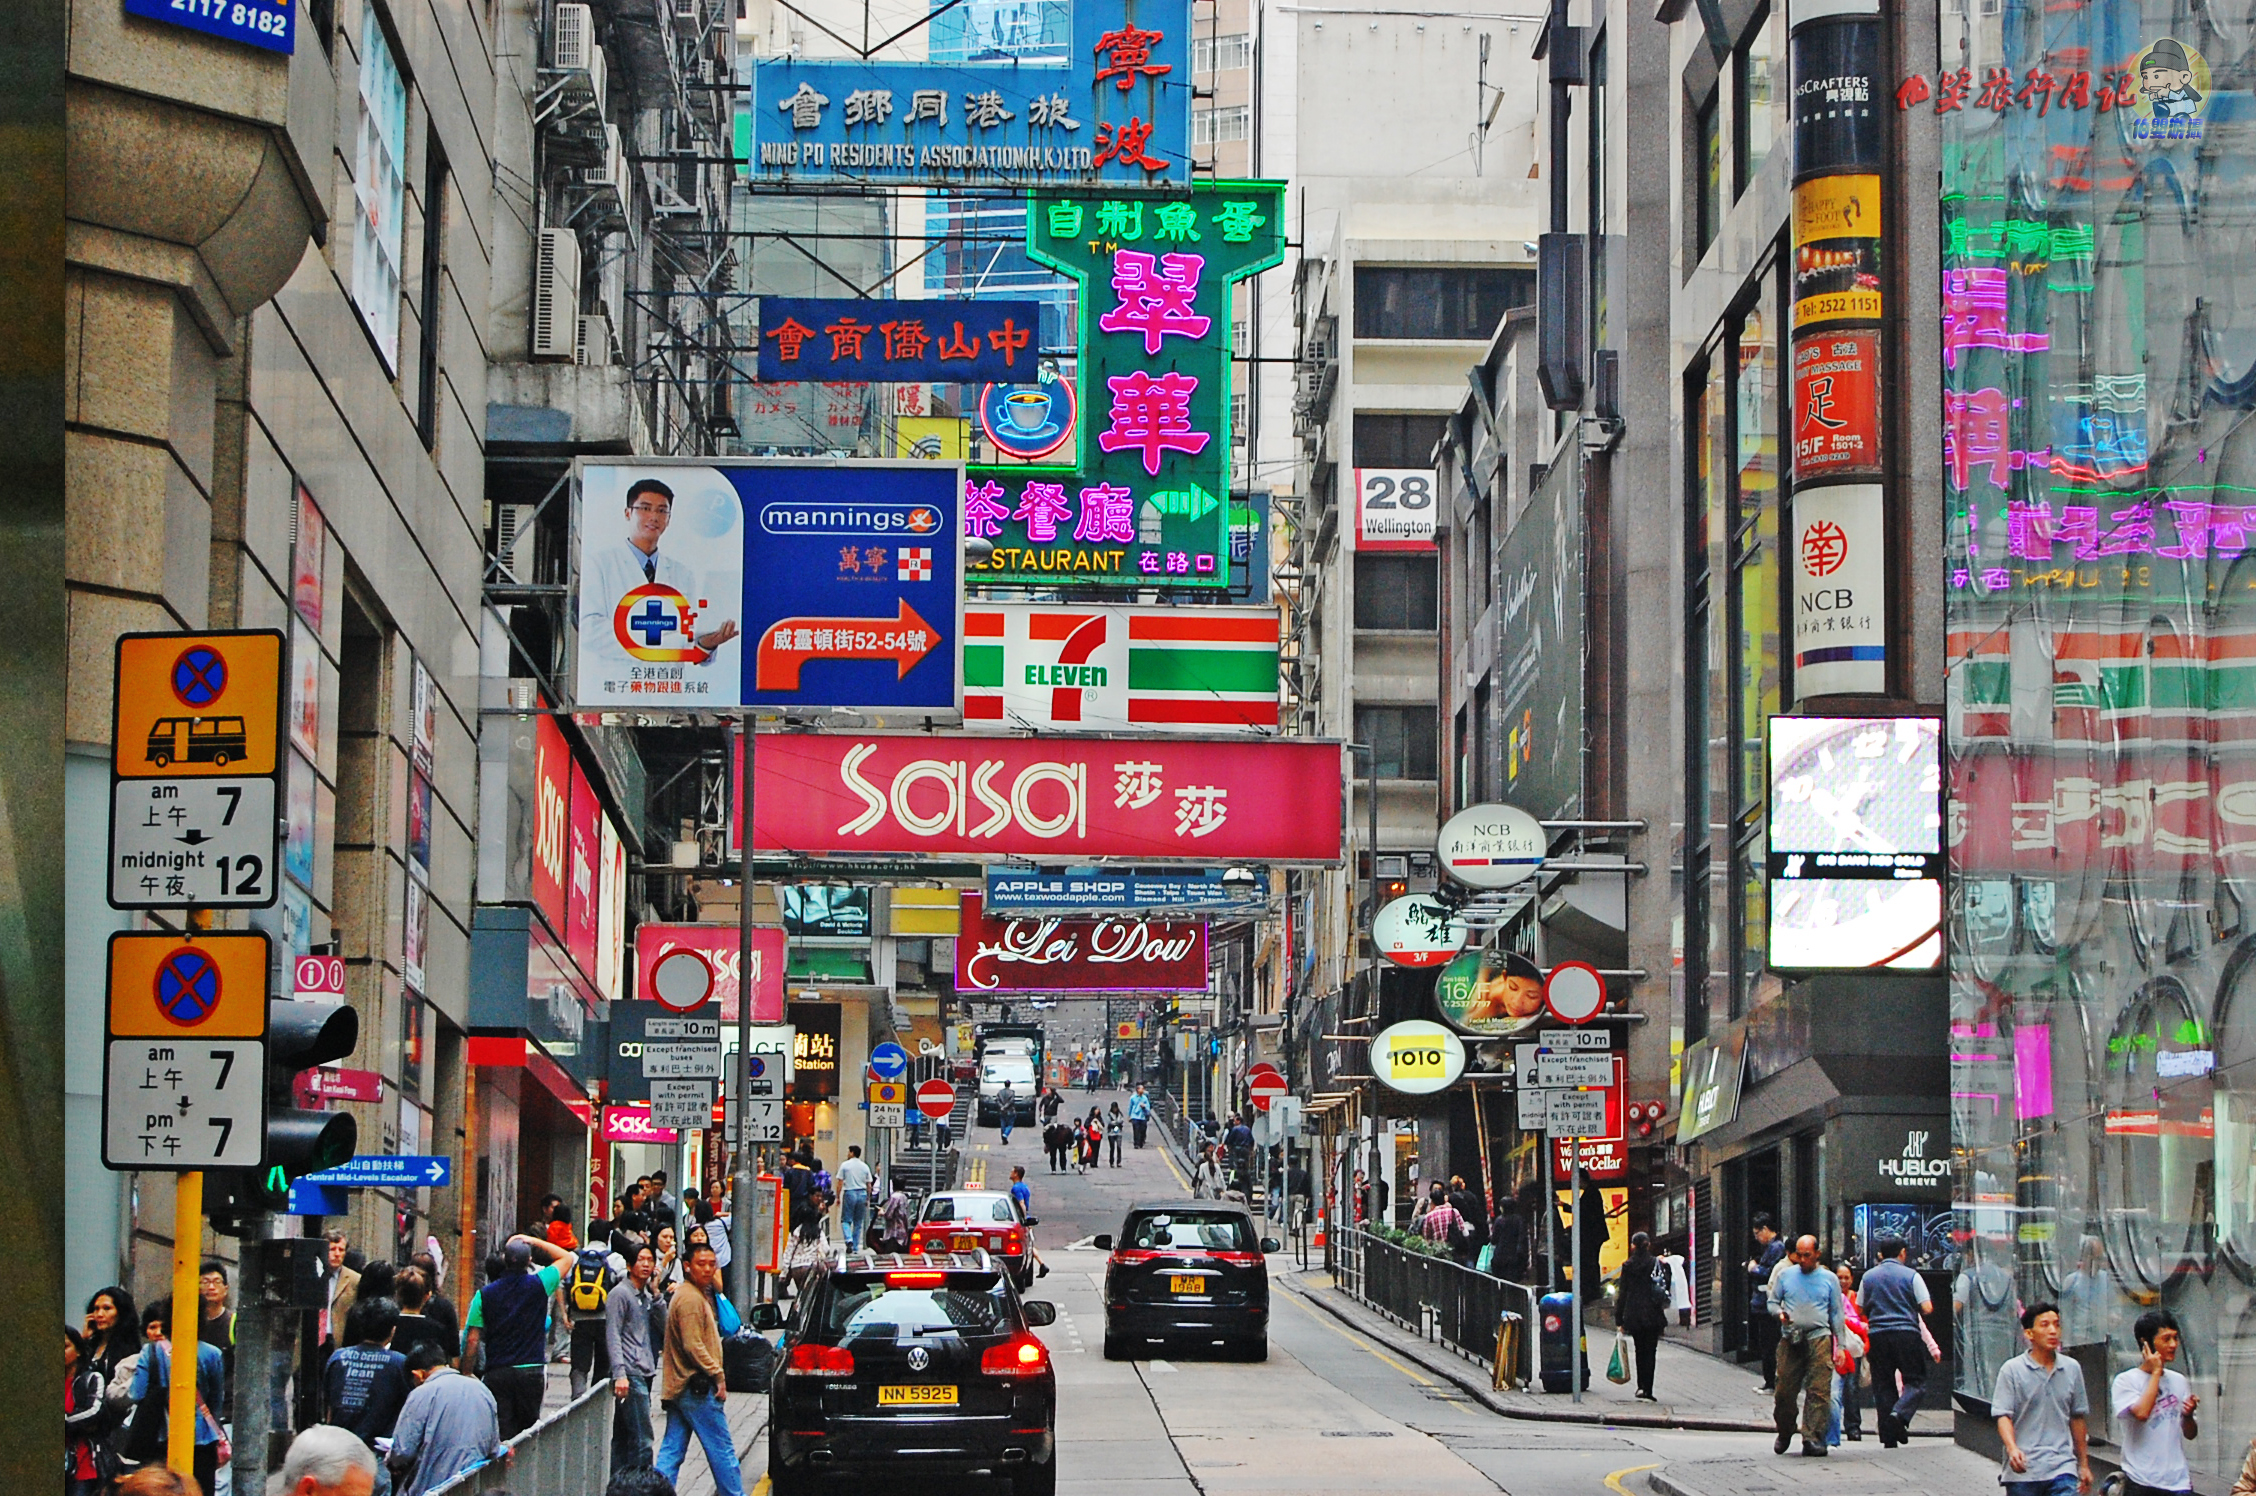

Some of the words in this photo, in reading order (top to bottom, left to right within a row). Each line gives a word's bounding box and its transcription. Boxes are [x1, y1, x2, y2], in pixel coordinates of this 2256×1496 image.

[231, 3, 287, 37] 8182
[1094, 22, 1172, 171] 寧波
[761, 142, 798, 165] NING
[803, 144, 824, 166] PO
[831, 144, 915, 168] RESIDENTS
[1089, 240, 1117, 254] TM
[1803, 302, 1817, 317] Tel:
[1820, 298, 1846, 313] 2522
[1851, 297, 1878, 311] 1151
[764, 316, 1031, 367] 中山僑商會
[1098, 247, 1211, 476] 翠華
[1811, 360, 1862, 375] MASSAGE
[1801, 376, 1848, 432] 足
[1830, 441, 1863, 450] 1501-2
[1832, 434, 1861, 442] Room
[1796, 436, 1824, 458] 15/F
[1366, 476, 1432, 510] 28
[768, 507, 906, 531] mannings
[1366, 517, 1432, 538] Wellington
[838, 546, 889, 573] 萬寧
[966, 548, 1125, 571] STAURANT
[1138, 550, 1216, 574] 在路口
[1801, 588, 1854, 614] NCB
[772, 628, 927, 653] 威靈頓街52-54號
[631, 667, 683, 680] 全港首創
[151, 785, 179, 799] am
[1114, 761, 1228, 838] 莎莎
[216, 787, 242, 826] 7
[141, 805, 187, 828] 上午
[1473, 824, 1511, 836] NCB
[121, 851, 205, 871] midnight
[216, 854, 264, 896] 12
[139, 875, 186, 898] 午夜
[995, 882, 1064, 892] APPLE
[1070, 882, 1126, 892] SHOP
[1134, 883, 1167, 891] Causeway
[1169, 883, 1181, 891] Bay
[994, 893, 1126, 904] www.texwoodapple.com
[1413, 952, 1429, 963] 3/F
[1442, 982, 1491, 1000] 16/F
[684, 1022, 699, 1034] 10
[702, 1025, 715, 1034] m
[1576, 1033, 1591, 1045] 10
[1594, 1035, 1607, 1045] m
[148, 1047, 175, 1061] am
[675, 1045, 717, 1053] franchised
[794, 1058, 835, 1070] Station
[1393, 1050, 1441, 1067] 1010
[209, 1050, 235, 1090] 7
[138, 1067, 184, 1091] 上午
[658, 1091, 676, 1099] with
[677, 1092, 705, 1100] permit
[667, 1084, 695, 1092] Except
[1562, 1093, 1589, 1101] Except
[762, 1103, 772, 1116] 7
[874, 1105, 886, 1113] 24
[887, 1105, 901, 1114] hrs
[146, 1114, 173, 1131] pm
[659, 1115, 703, 1126] 不在此限
[876, 1115, 898, 1125] 全日
[763, 1125, 780, 1139] 12
[1555, 1124, 1598, 1134] 不在此限
[208, 1117, 233, 1158] 7
[138, 1135, 182, 1157] 下午
[1560, 1145, 1595, 1157] Waon's
[328, 1159, 405, 1171] 半山自動扶梯
[1560, 1158, 1589, 1171] Wne
[1589, 1155, 1622, 1171] Cellar
[1879, 1159, 1951, 1176] HUBLOT
[306, 1173, 336, 1182] Central
[336, 1174, 379, 1182] Mid-Levels
[380, 1174, 418, 1182] Escalator
[1895, 1177, 1937, 1186] GENEVE
[884, 1388, 905, 1400] NN
[910, 1387, 952, 1400] 5925
